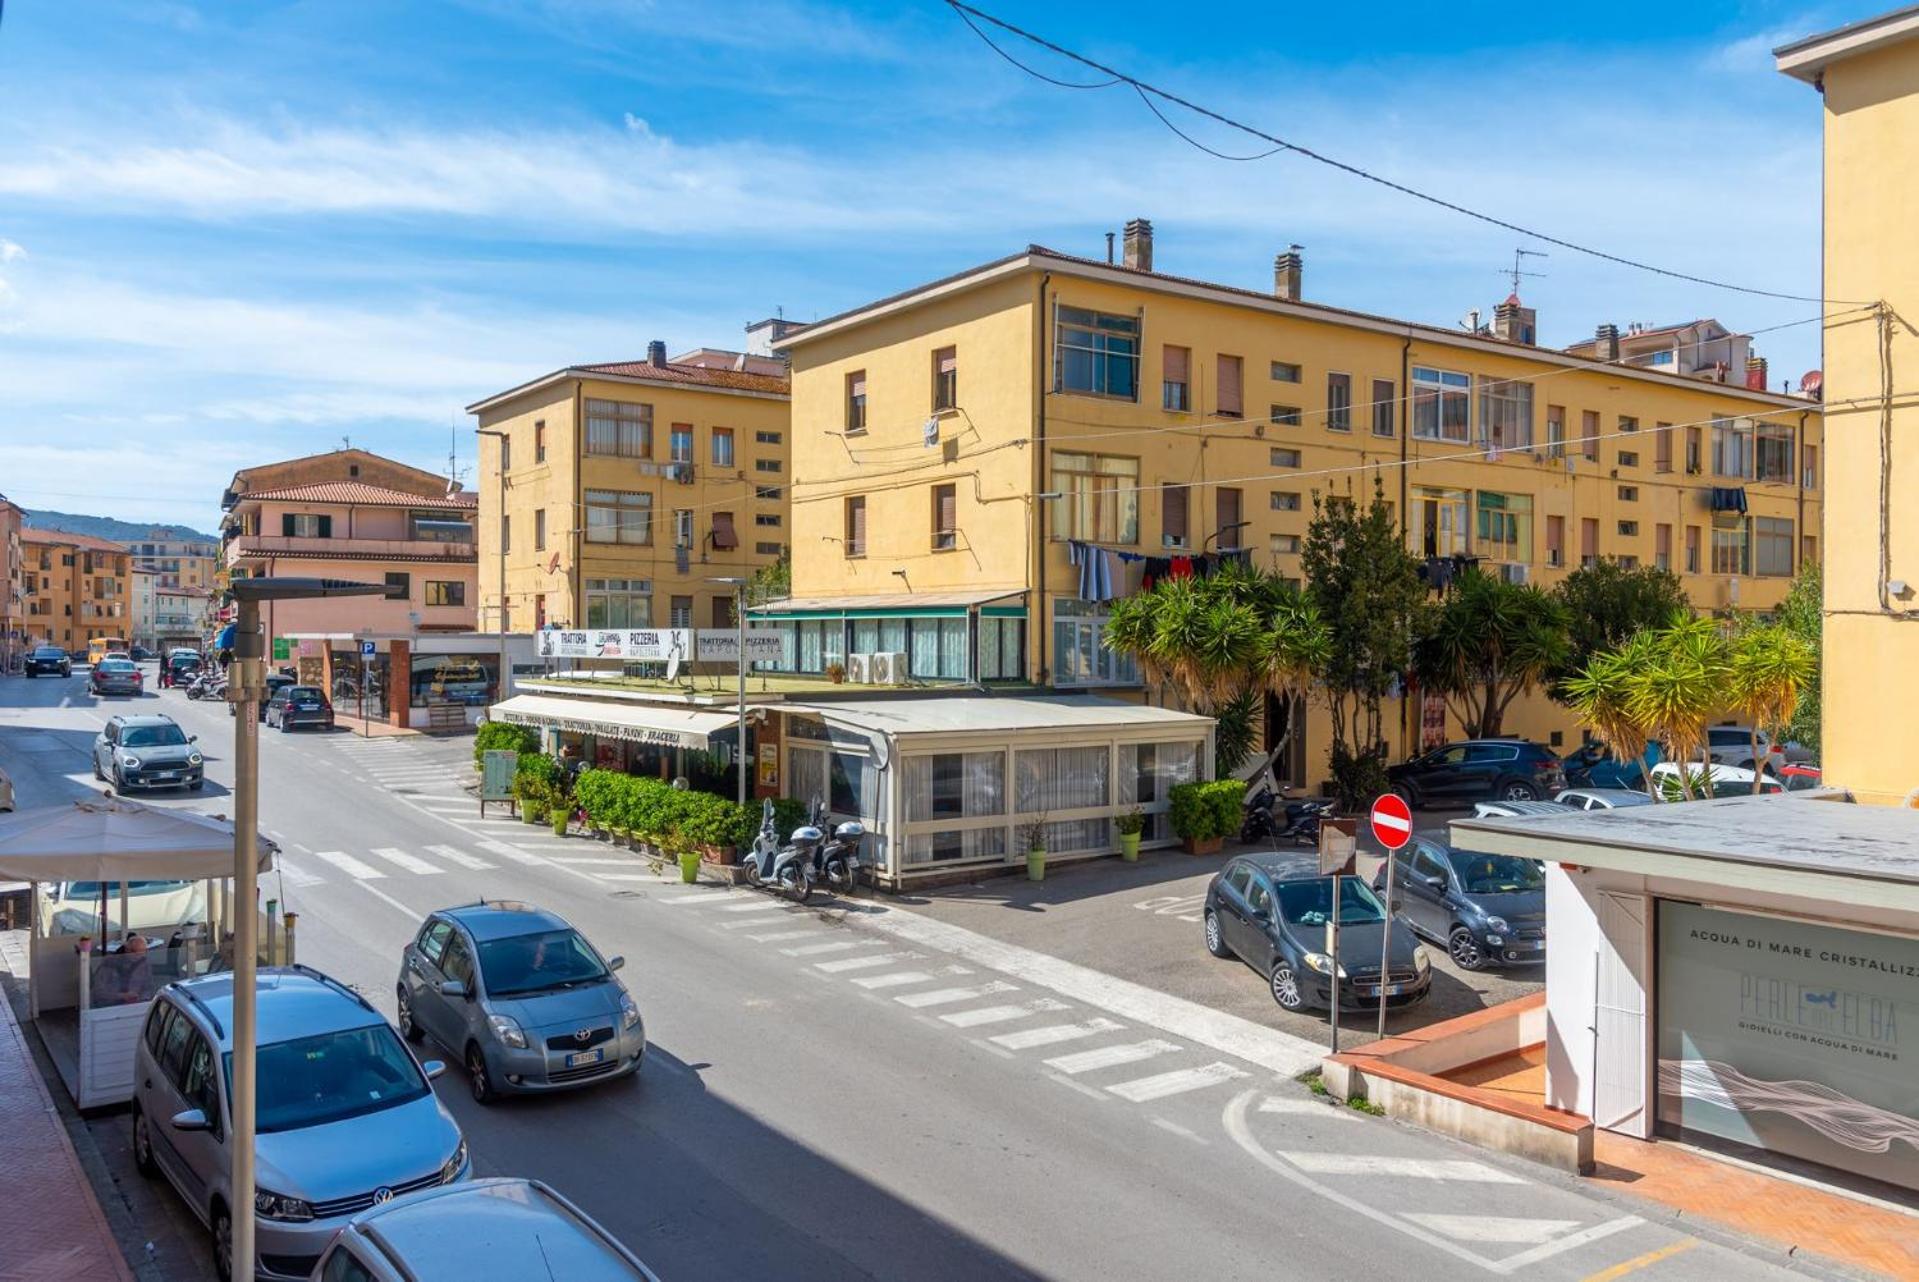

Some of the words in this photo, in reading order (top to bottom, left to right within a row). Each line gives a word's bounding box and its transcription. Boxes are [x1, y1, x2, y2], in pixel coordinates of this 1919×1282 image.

[561, 632, 587, 645] TRATTORIA
[630, 632, 659, 645] PIZZERIA
[364, 642, 373, 653] P
[1690, 930, 1740, 945] ACQUA
[1747, 939, 1761, 950] DI
[1769, 942, 1812, 958] MARE
[1739, 1021, 1782, 1036] GIOIELLI
[1784, 1031, 1807, 1041] CON
[1810, 1037, 1848, 1049] ACQUA
[1851, 1045, 1862, 1053] DI
[1866, 1048, 1898, 1060] MARE
